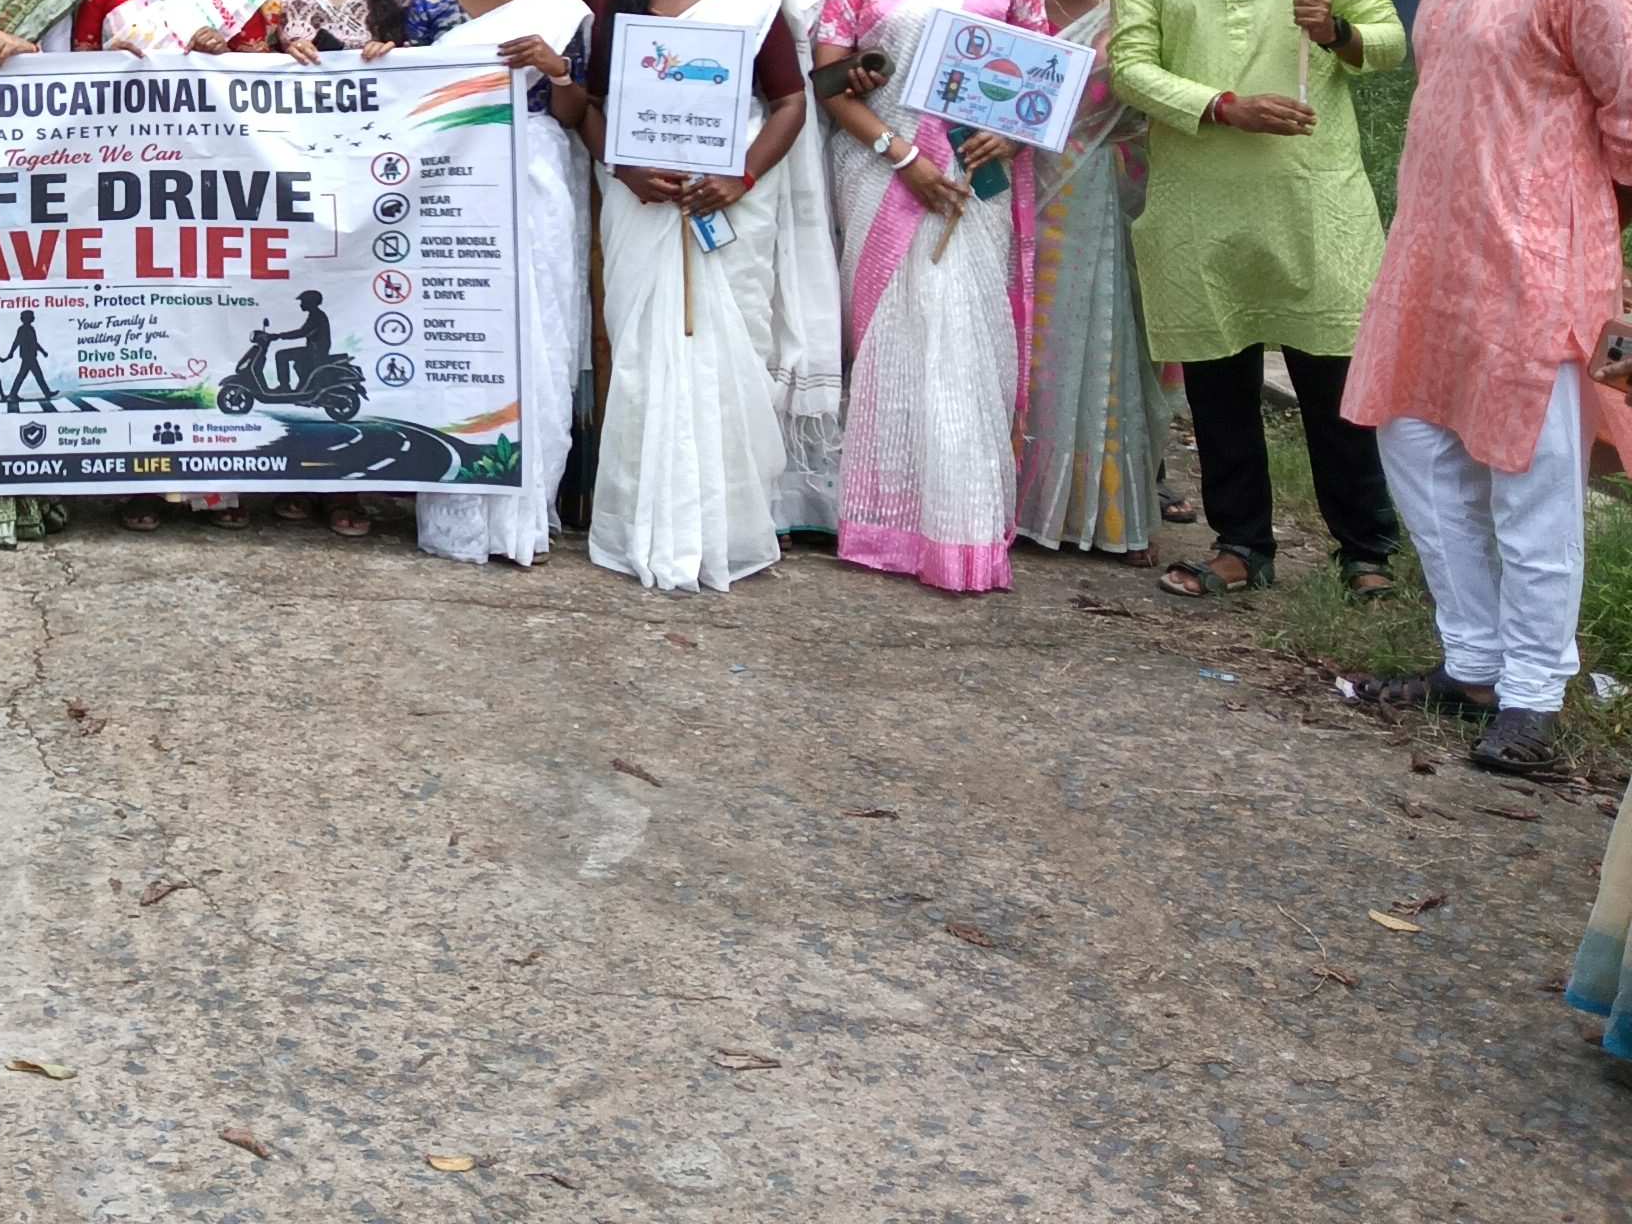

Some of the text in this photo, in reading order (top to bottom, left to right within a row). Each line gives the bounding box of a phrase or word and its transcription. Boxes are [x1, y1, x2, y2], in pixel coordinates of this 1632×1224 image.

[229, 77, 379, 114] COLLEGE
[37, 126, 117, 140] SAFETY
[130, 124, 250, 137] INITIATIVE
[5, 144, 183, 171] Together We Can
[420, 155, 450, 167] WEAR
[420, 166, 473, 178] SEAT BELT
[98, 170, 314, 222] DRIVE
[420, 194, 450, 206] WEAR
[420, 207, 463, 218] HELMET
[420, 235, 497, 247] AVOID MOBILE
[135, 226, 290, 280] LIFE
[421, 249, 501, 260] WHILE DRIVING
[422, 277, 490, 288] DON'T DRINK
[45, 295, 90, 310] Rules,
[93, 294, 145, 307] Protect
[150, 292, 213, 307] Precious
[218, 293, 259, 307] Lives.
[423, 290, 465, 301] & DRIVE
[105, 314, 146, 331] Family
[149, 315, 158, 326] is
[424, 318, 455, 329] DON'T
[77, 331, 121, 347] waiting
[124, 328, 141, 345] for
[424, 331, 486, 342] OVERSPEED
[77, 348, 117, 363] Drive
[425, 359, 471, 371] RESPECT
[78, 364, 168, 379] Reach Safe.
[425, 373, 505, 385] TRAFFIC RULES
[58, 425, 107, 436] Obey Rules
[192, 422, 262, 433] Be Responsible
[58, 436, 101, 446] Stay Safe
[192, 434, 204, 443] Be
[216, 434, 237, 443] Hero
[2, 459, 68, 477] TODAY,
[80, 457, 125, 474] SAFE
[133, 456, 171, 472] LIFE
[179, 455, 288, 473] TOMORROW
